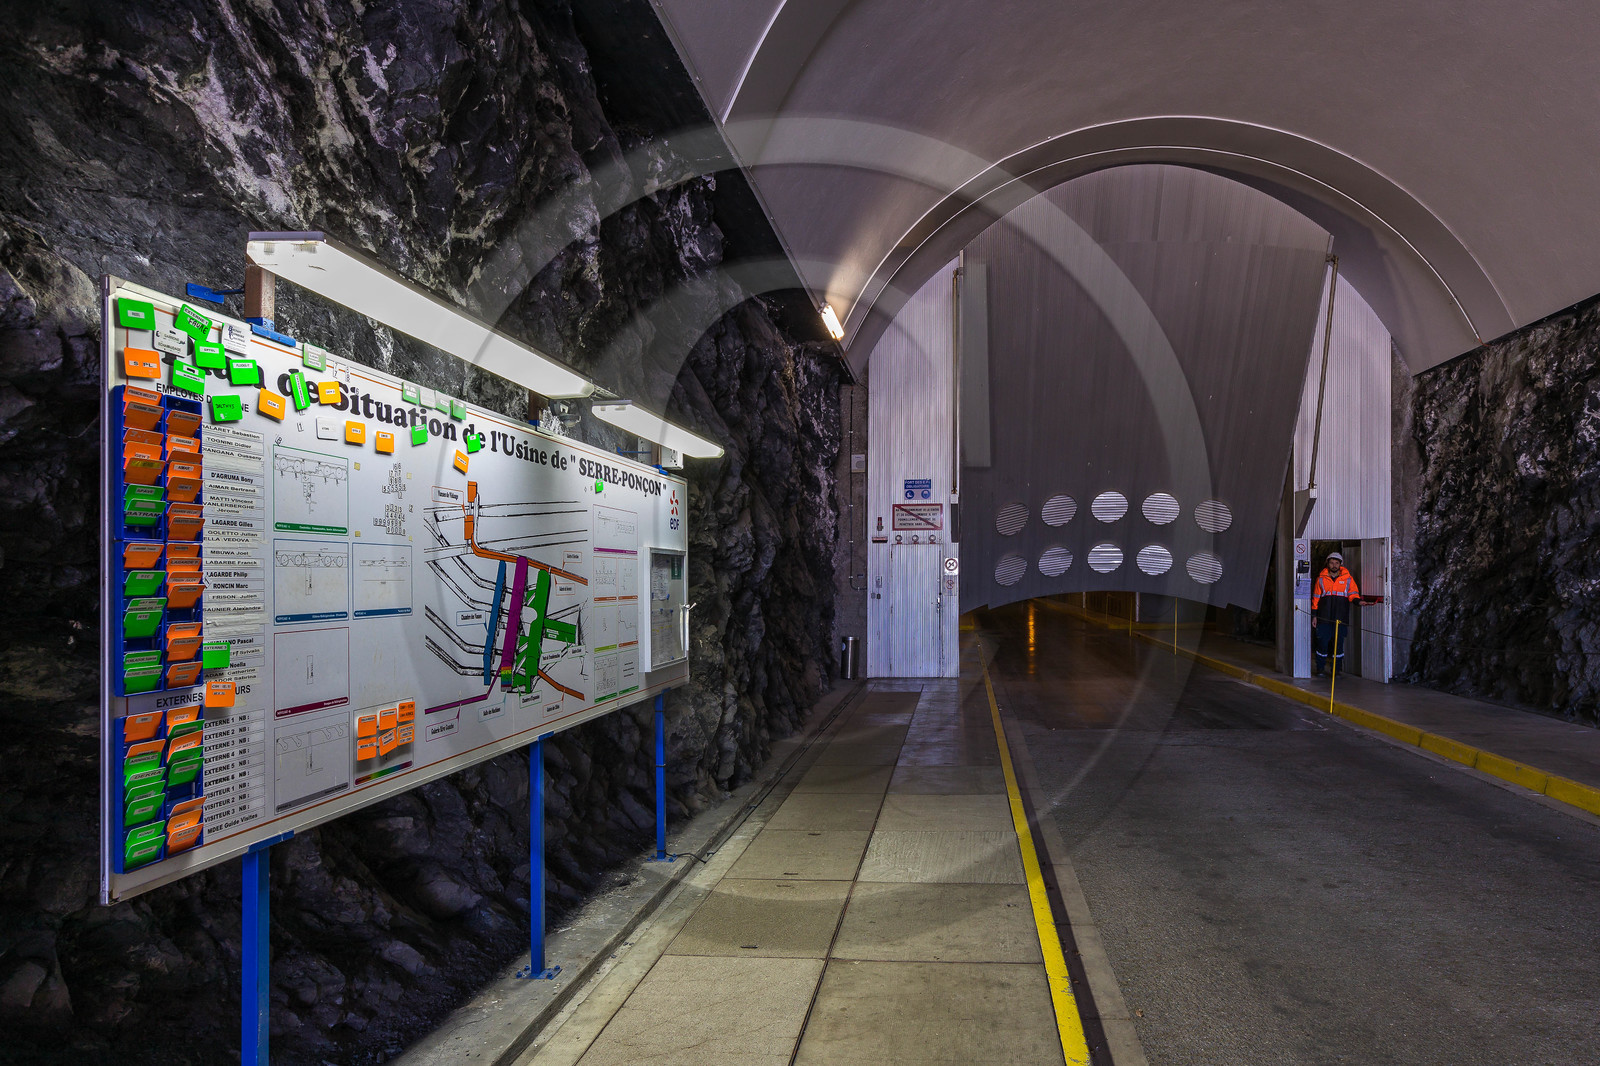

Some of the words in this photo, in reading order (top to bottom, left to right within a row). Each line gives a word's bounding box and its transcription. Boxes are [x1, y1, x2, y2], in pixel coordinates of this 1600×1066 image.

[156, 382, 204, 402] EMPLOYES
[277, 368, 319, 404] de
[330, 380, 458, 441] Situation
[462, 424, 486, 449] de
[490, 430, 548, 466] l'Usine
[551, 450, 568, 472] de
[578, 458, 662, 497] SERRE-PONÇON
[210, 472, 240, 481] D'AGRUMA
[156, 692, 204, 708] EXTERNES
[204, 718, 230, 729] EXTERNE
[204, 730, 231, 740] EXTERNE
[204, 742, 231, 752] EXTERNE
[204, 753, 231, 764] EXTERNE
[204, 764, 231, 776] EXTERNE
[204, 776, 231, 787] EXTERNE
[204, 787, 230, 798] VISITEUR
[204, 799, 230, 811] VISITEUR
[204, 810, 230, 822] VISITEUR
[207, 824, 223, 834] MDEE
[224, 820, 240, 828] Guide
[240, 813, 258, 822] Visites
